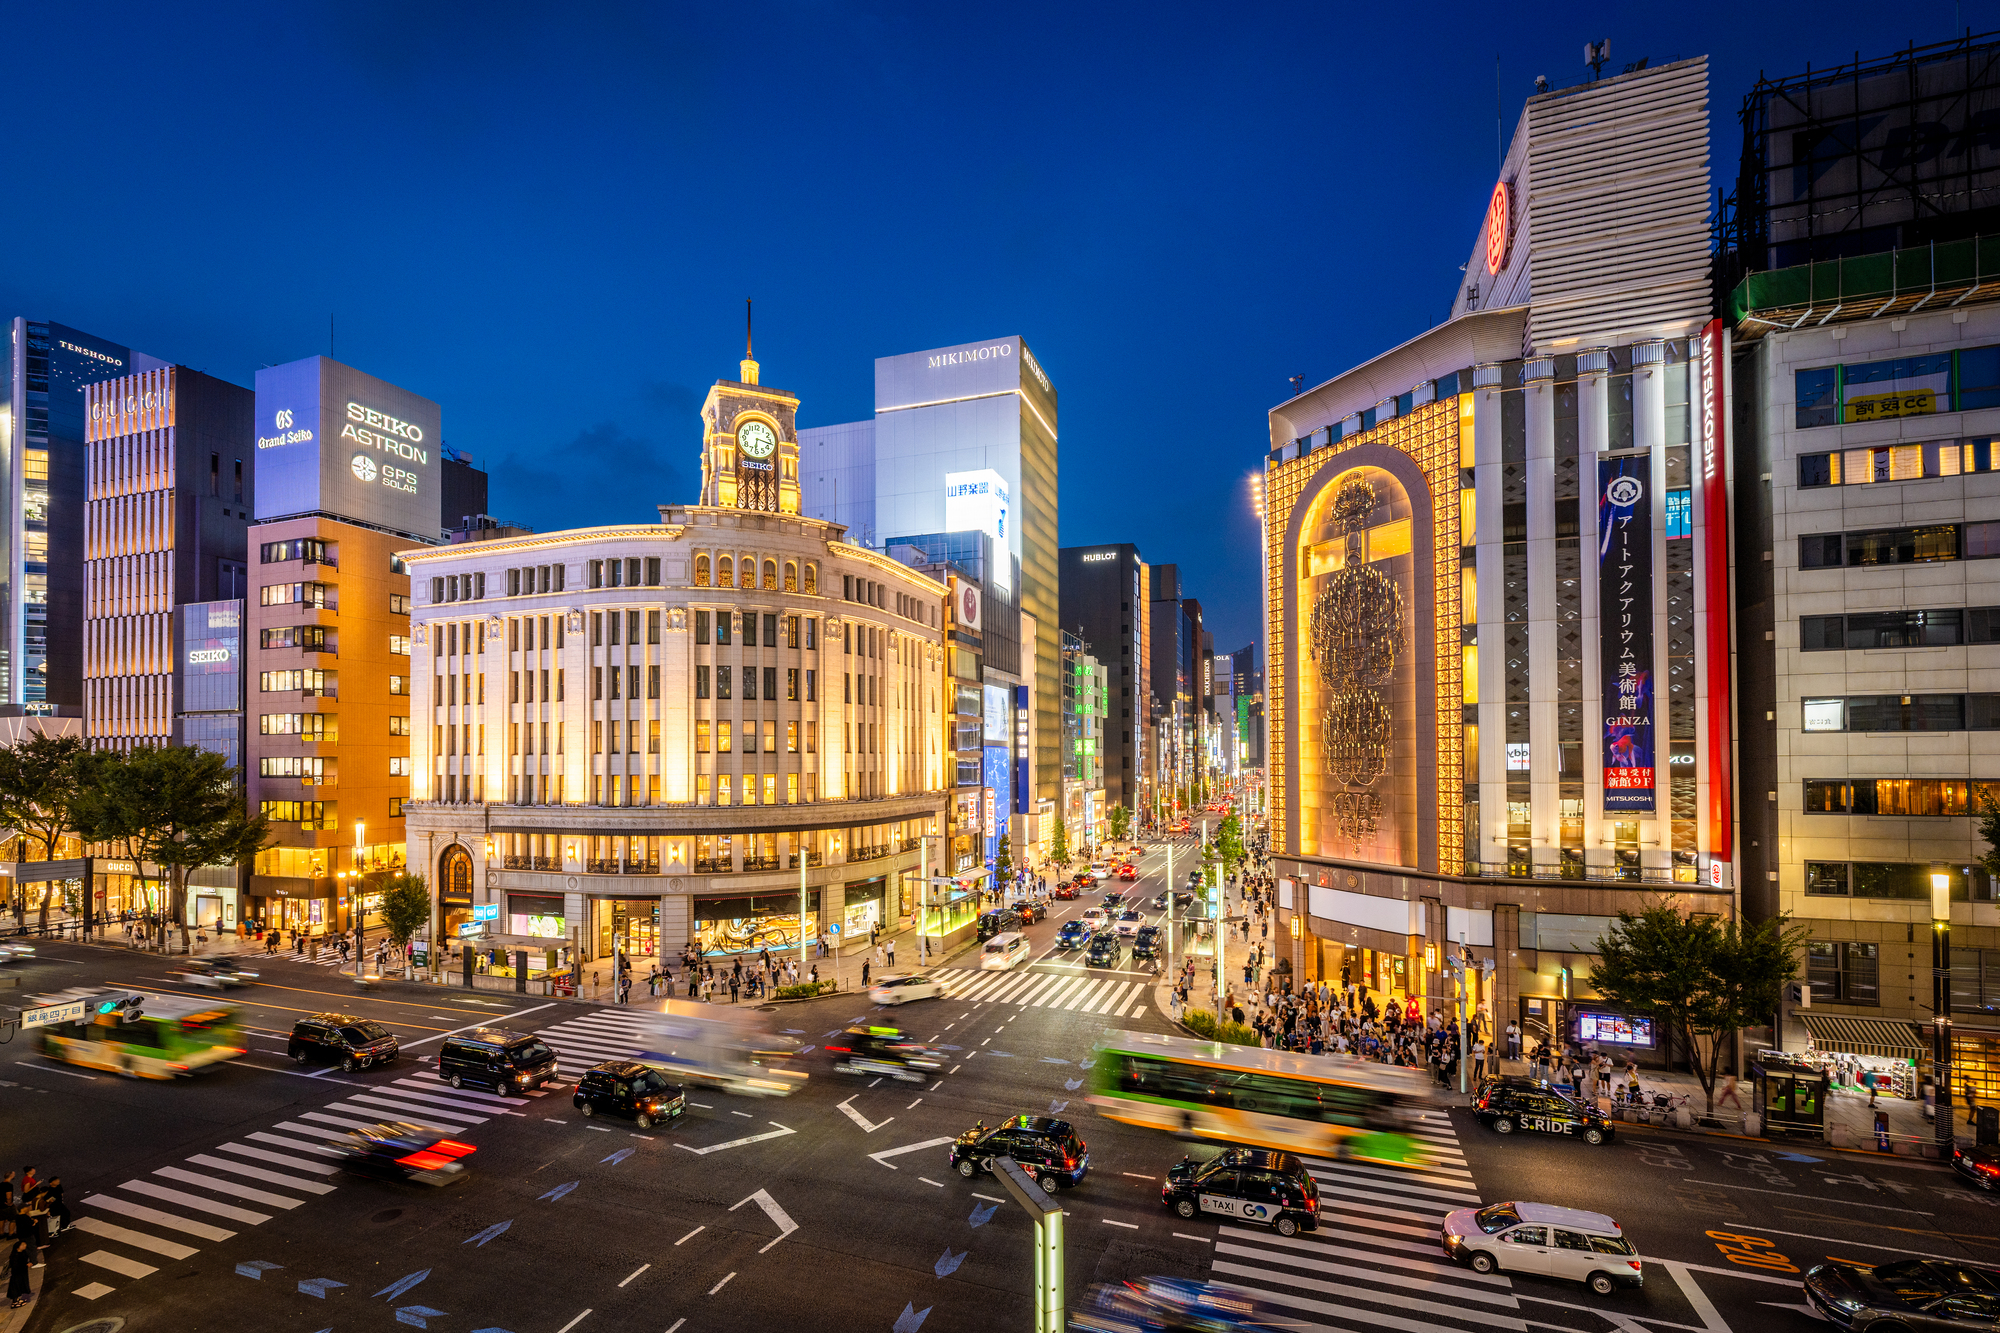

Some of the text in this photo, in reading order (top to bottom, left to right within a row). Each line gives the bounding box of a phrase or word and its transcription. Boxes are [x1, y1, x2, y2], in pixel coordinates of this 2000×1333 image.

[59, 340, 123, 367] TENSHODO
[928, 343, 1012, 369] MIKIMOTO
[1023, 347, 1049, 391] MIKIMOTO
[90, 388, 168, 421] GUCCI
[1703, 332, 1715, 480] MITSUKOSHI
[276, 409, 294, 430] GS
[347, 402, 424, 442] SEIKO
[258, 429, 314, 449] Grand Seiko
[341, 423, 427, 465] ASTRON
[382, 464, 417, 485] GPS
[742, 460, 773, 471] SEIKO
[382, 477, 417, 495] SOLAR
[947, 481, 989, 498] 山野楽器
[1083, 552, 1117, 562] HUBLOT
[1618, 515, 1638, 711] アートアクアリウム美術館
[189, 649, 229, 663] SEIKO
[1083, 665, 1093, 715] 教文館
[1606, 716, 1651, 726] GINZA
[1608, 768, 1651, 777] 入場受付
[107, 863, 133, 872] GUCCI
[28, 1006, 81, 1023] 銀座四丁目
[1520, 1117, 1573, 1135] S.RIDE
[1212, 1199, 1234, 1211] TAXI
[1705, 1229, 1800, 1274] 8-20
